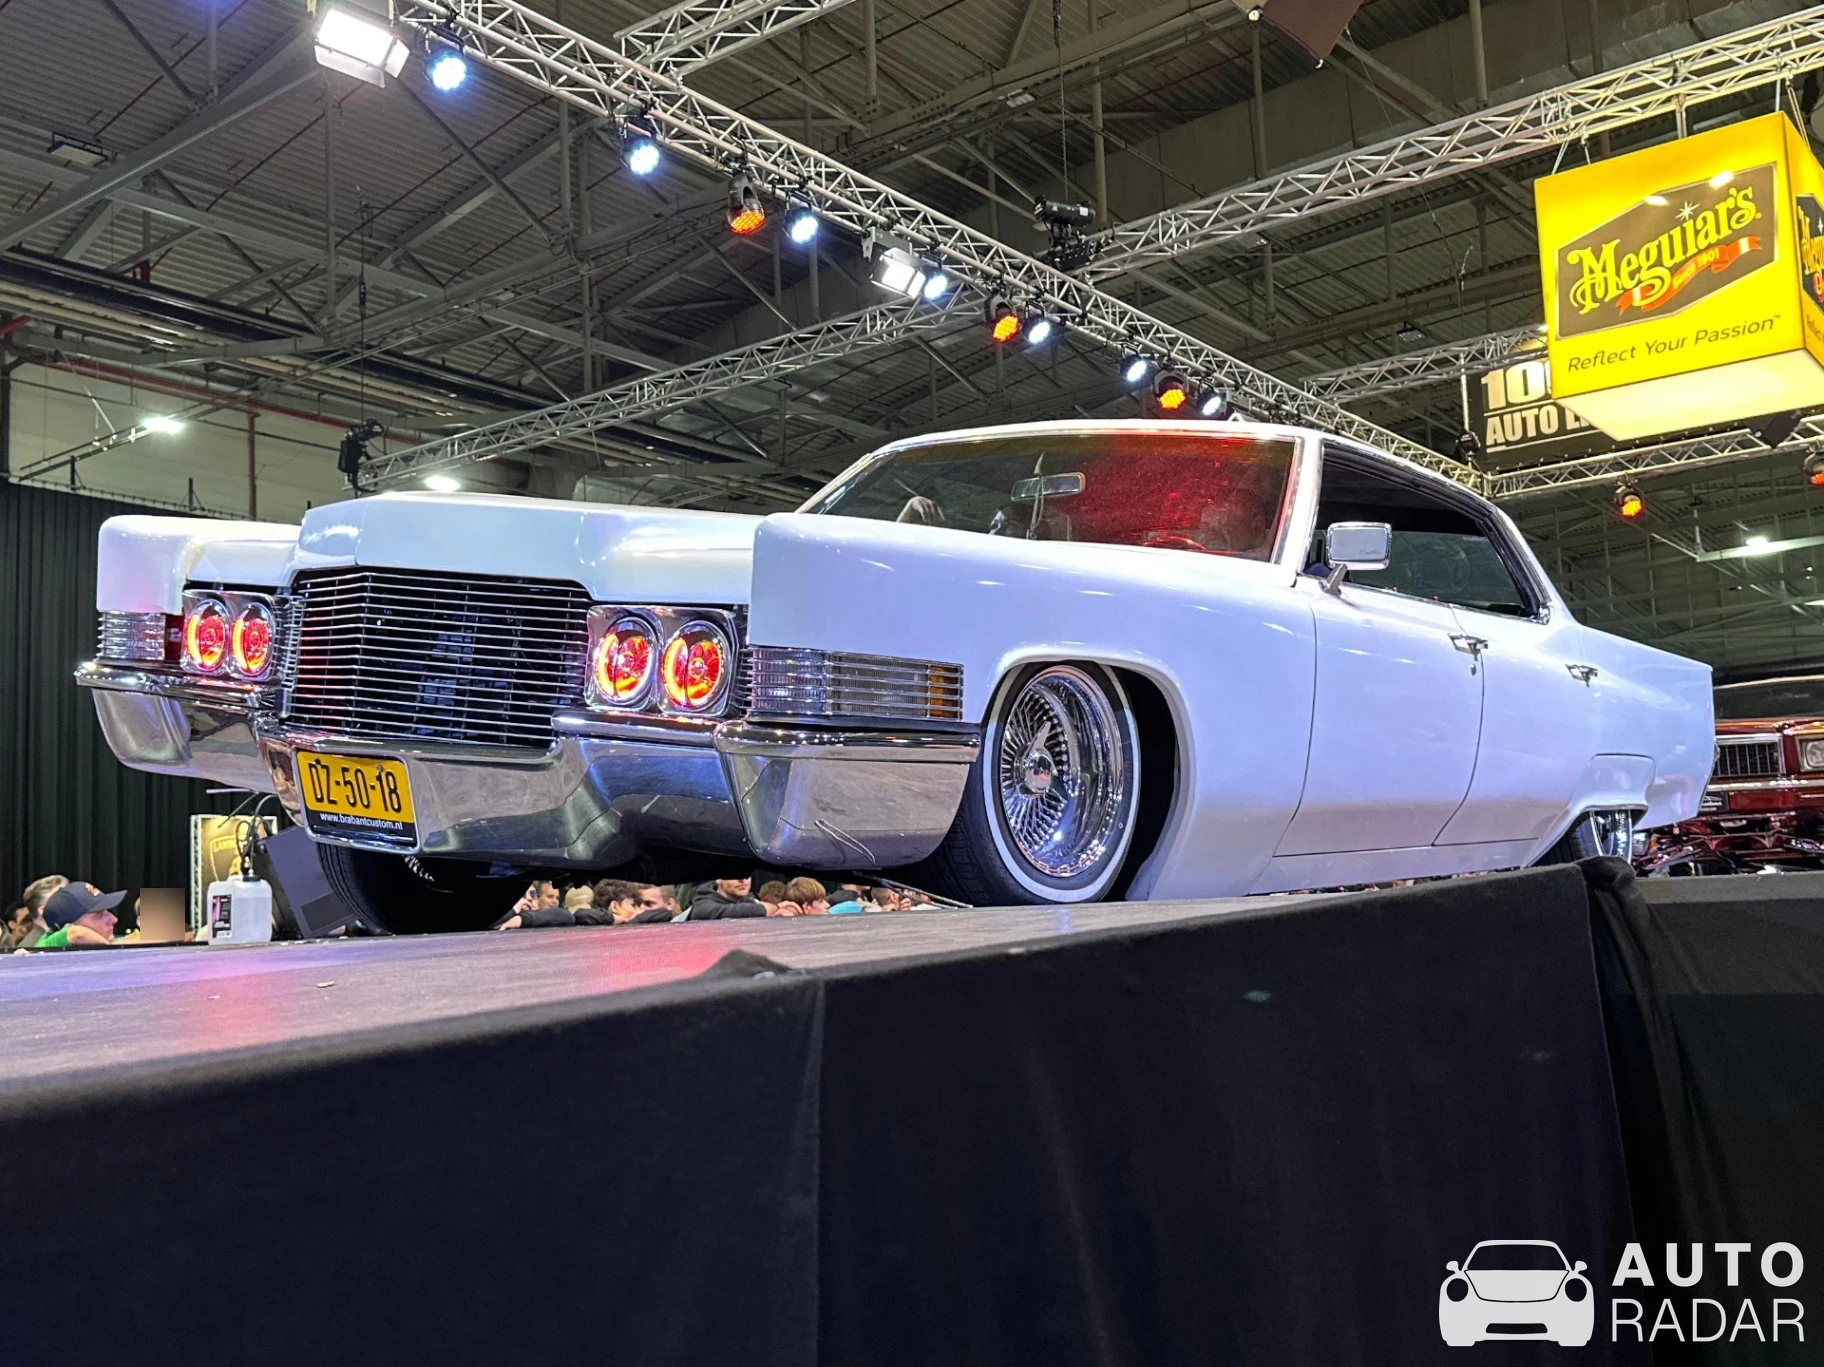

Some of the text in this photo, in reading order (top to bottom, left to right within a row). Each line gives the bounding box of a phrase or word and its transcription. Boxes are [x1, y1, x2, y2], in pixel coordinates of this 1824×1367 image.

[1567, 186, 1757, 314] Meguiar's
[1567, 346, 1637, 373] Reflect
[1645, 336, 1688, 355] Your
[1481, 360, 1552, 410] 10
[1486, 404, 1559, 446] AUTO
[308, 760, 402, 813] DZ-50-18
[320, 812, 403, 830] www.brabantcustom.nl
